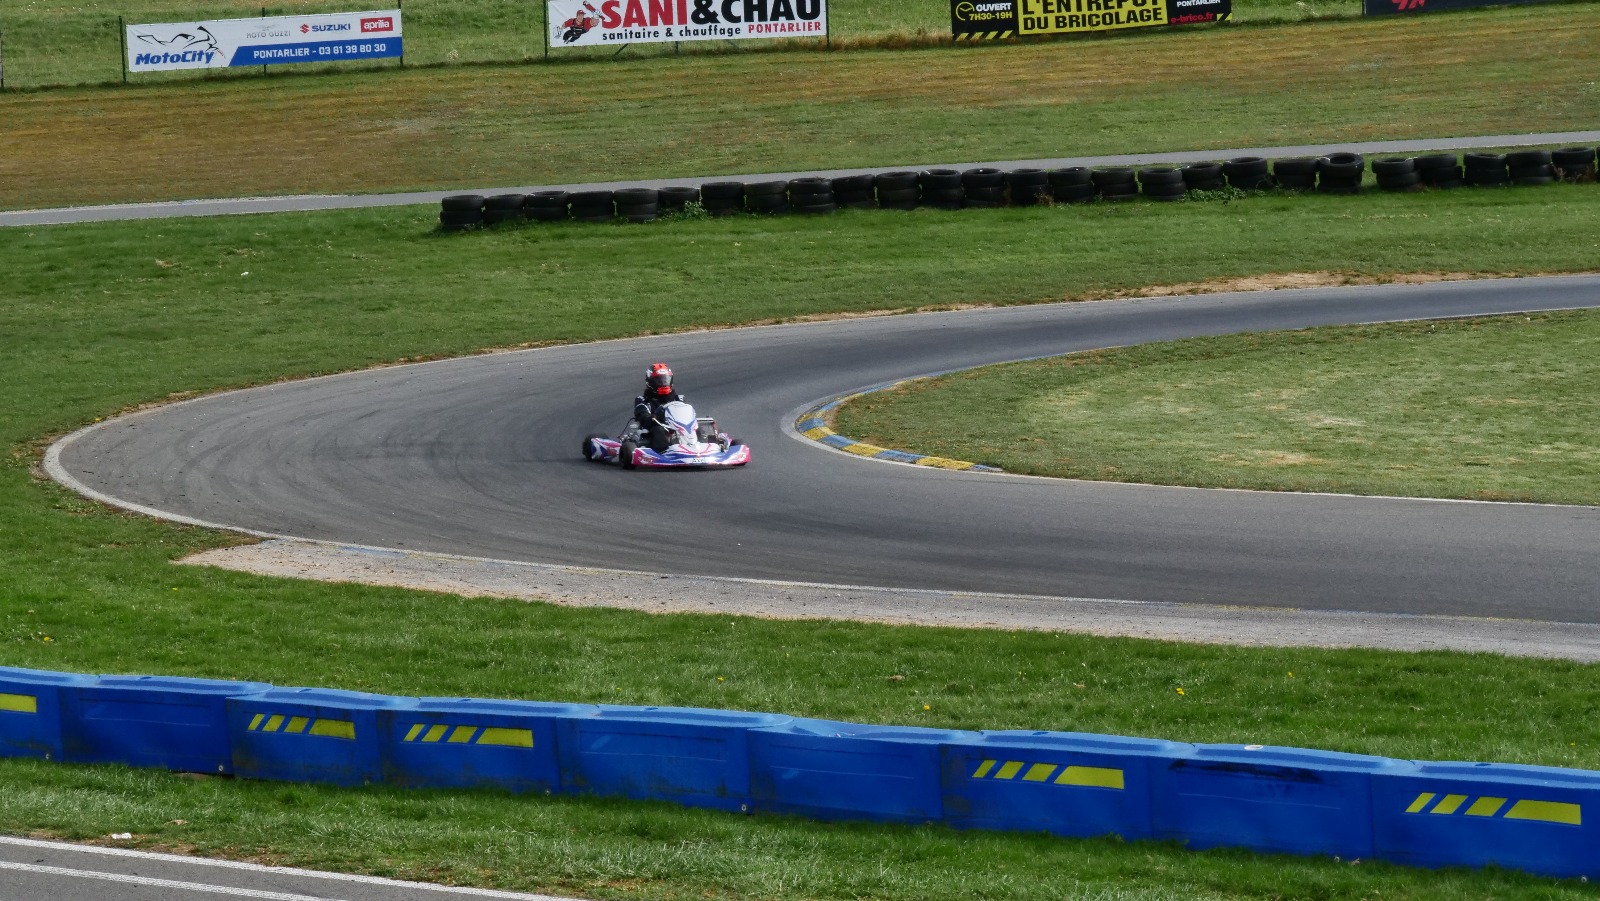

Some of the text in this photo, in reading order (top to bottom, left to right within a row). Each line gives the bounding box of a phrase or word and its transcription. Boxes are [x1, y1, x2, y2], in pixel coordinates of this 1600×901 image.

[975, 2, 1012, 12] OUVERT
[968, 11, 1013, 21] 7H30-19H
[1023, 7, 1163, 31] DU BRICOLAGE
[1171, 12, 1214, 23] e-brico.fr
[312, 23, 351, 33] SUZUKI
[363, 19, 391, 30] aprilia
[602, 21, 822, 41] sanitaire & chauffage PONTARLIER
[253, 47, 310, 59] PONTARLIER
[318, 45, 331, 56] 03
[333, 45, 343, 55] 81
[345, 44, 358, 54] 39
[360, 43, 372, 53] 80
[374, 43, 387, 53] 30
[135, 50, 214, 66] MotoCity
